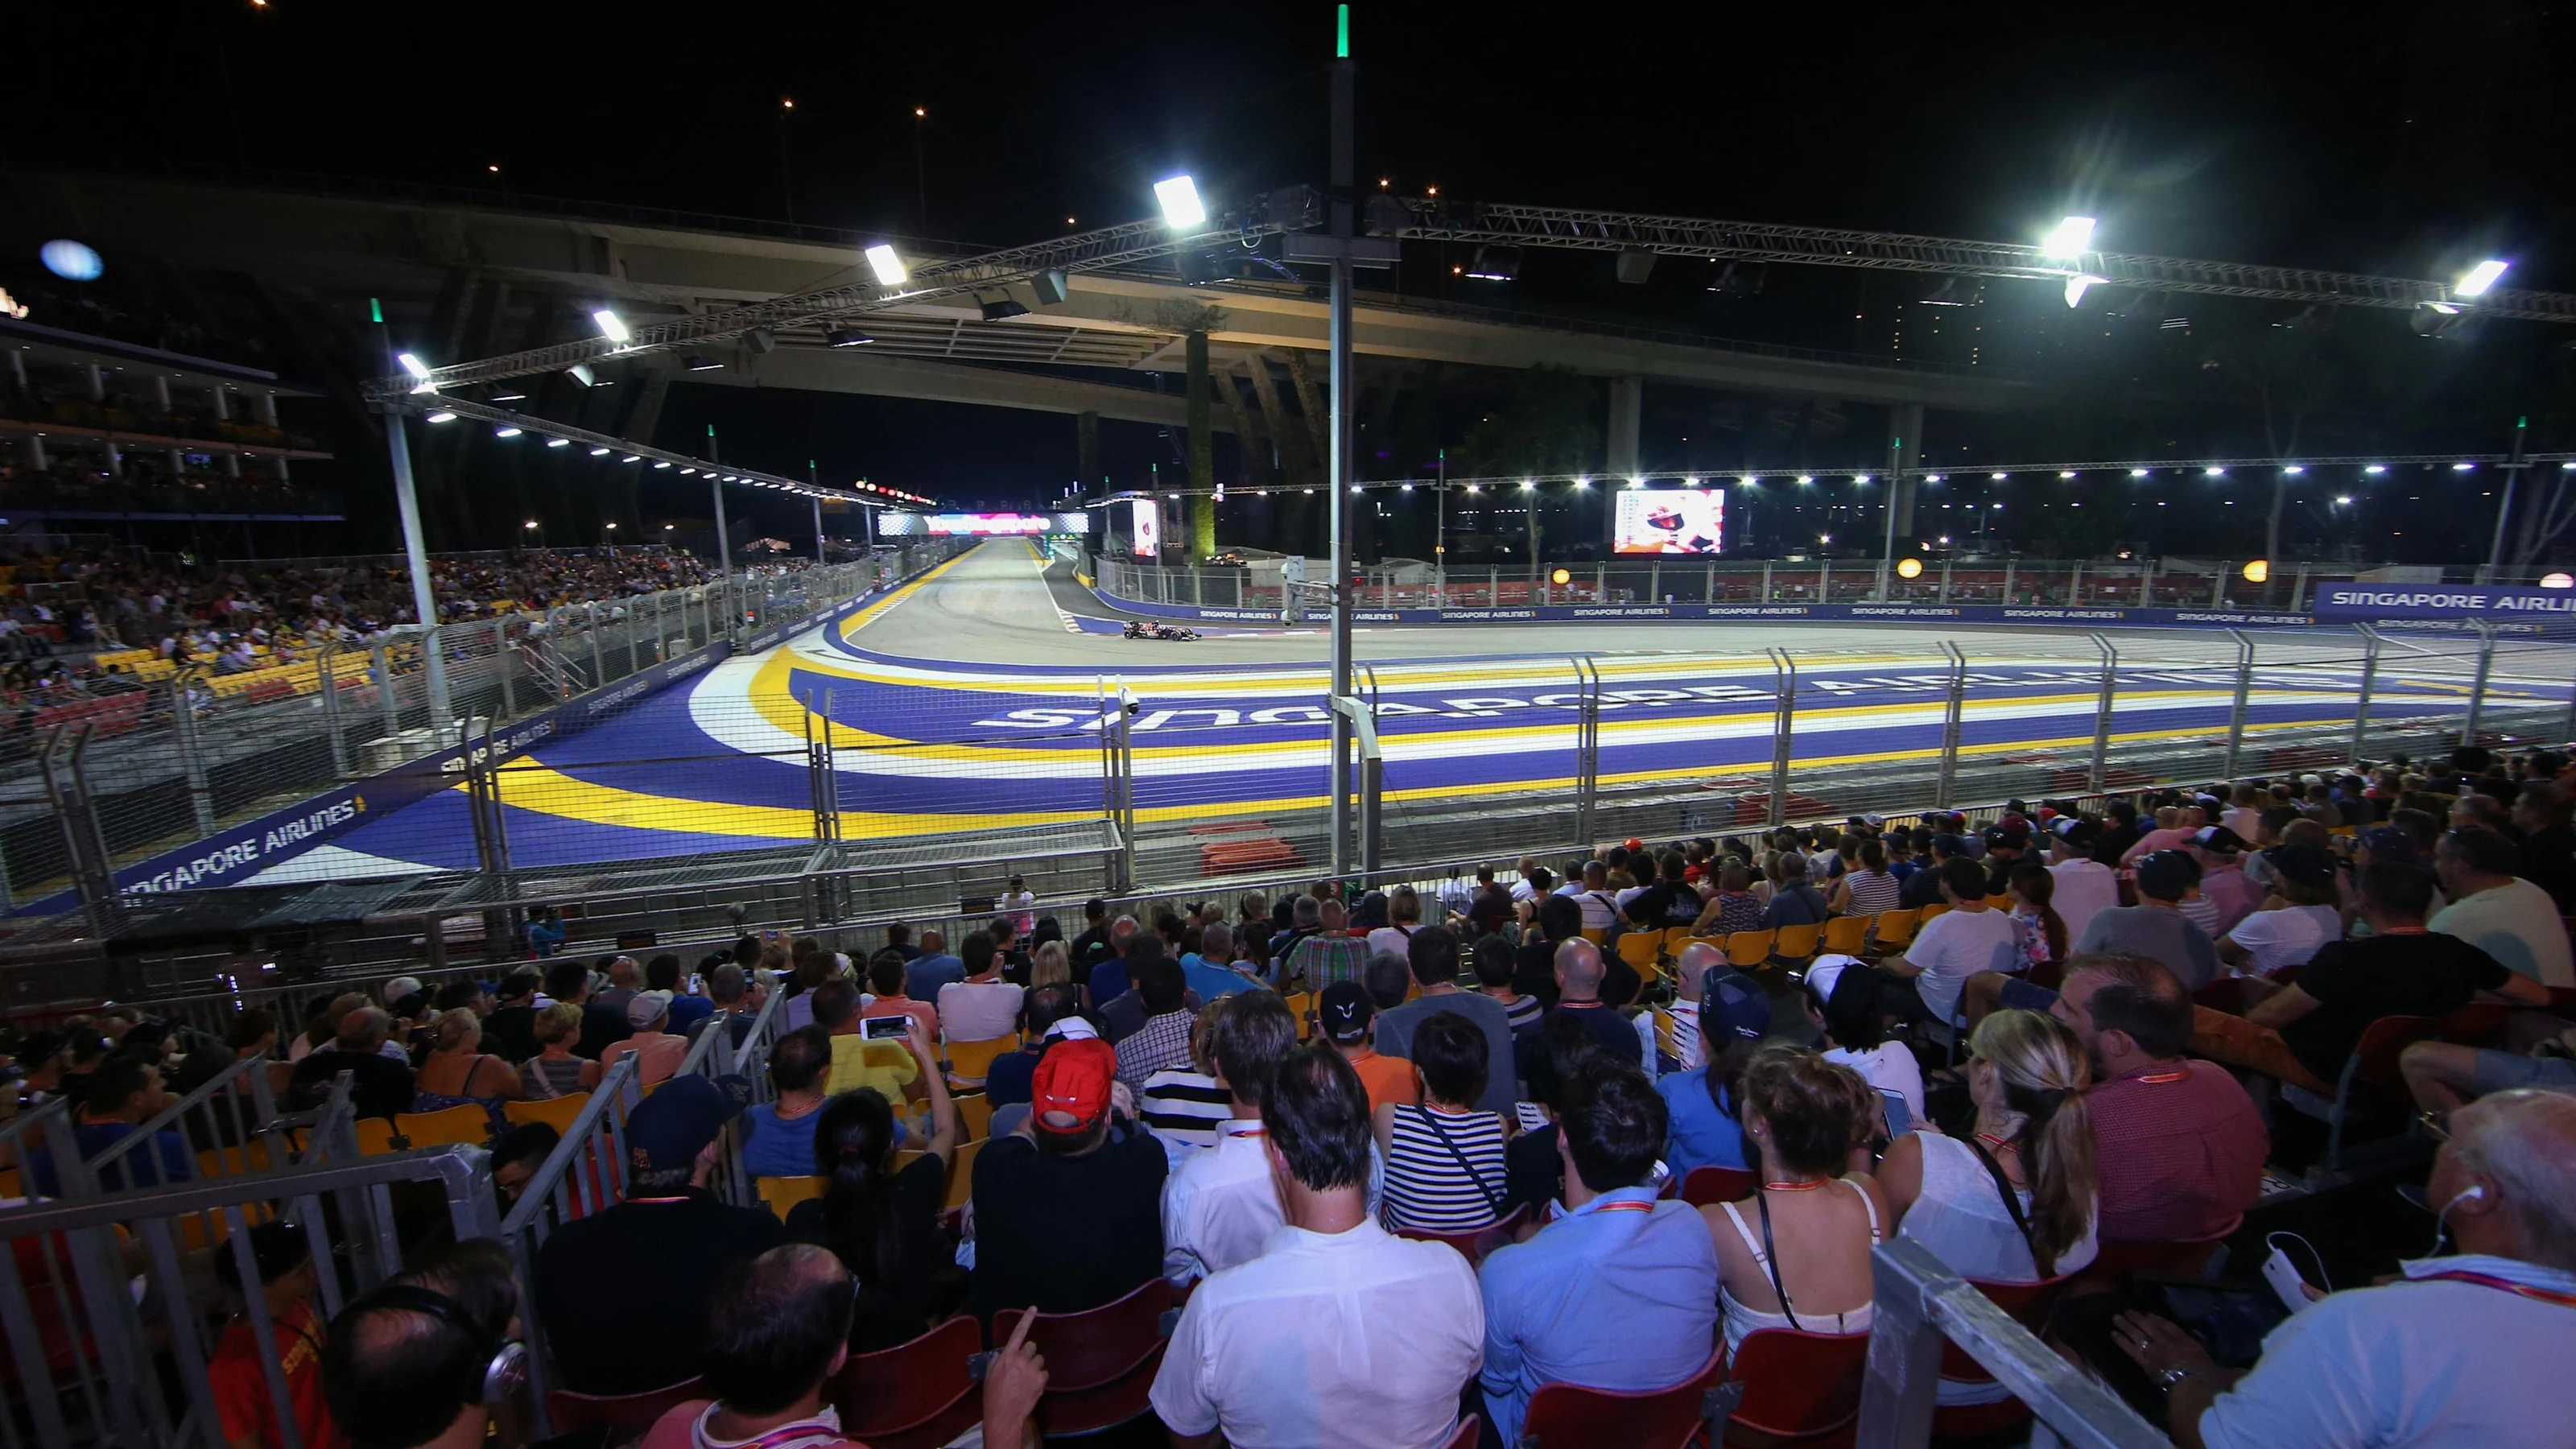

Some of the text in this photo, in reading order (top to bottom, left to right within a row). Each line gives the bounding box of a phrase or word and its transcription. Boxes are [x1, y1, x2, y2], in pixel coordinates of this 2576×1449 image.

[2331, 592, 2487, 609] SINGAPORE
[1199, 610, 1272, 620] SINGAPORE AIRLINES
[1492, 610, 1531, 618] AIRLINES
[1574, 607, 1664, 617] SINGAPORE AIRLINES
[1761, 607, 1802, 615] AIRLINES
[1852, 608, 1953, 616] SINGAPORE AIRLINES
[2004, 609, 2117, 619] SINGAPORE AIRLINES
[2176, 613, 2306, 625] SINGAPORE AIRLINES
[264, 799, 355, 853] AIRLINES
